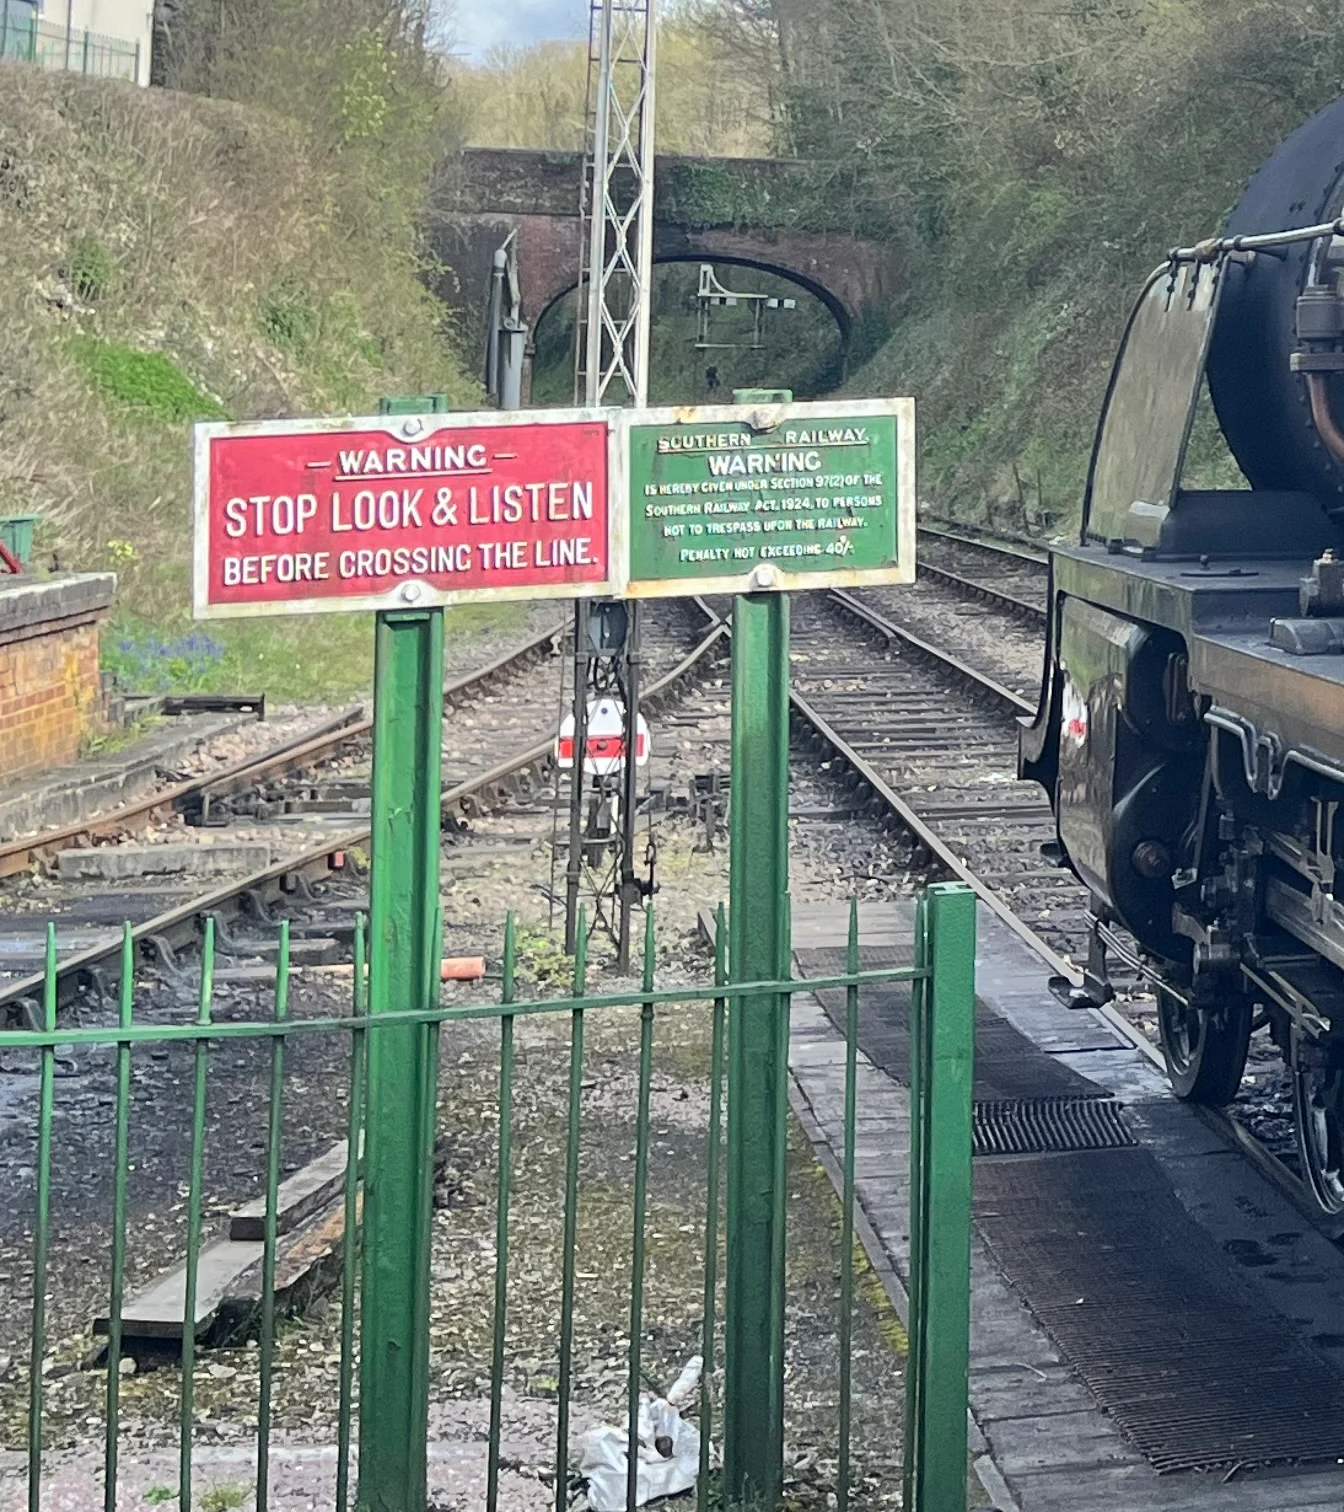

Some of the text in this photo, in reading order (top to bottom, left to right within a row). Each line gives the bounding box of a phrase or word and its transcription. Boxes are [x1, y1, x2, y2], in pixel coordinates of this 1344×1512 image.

[658, 433, 751, 449] SOUTHERN
[338, 444, 487, 474] WARNING
[708, 451, 821, 476] WARNING
[644, 484, 657, 496] IS
[660, 483, 700, 495] HEREBY
[700, 481, 733, 494] GIVEN
[734, 479, 768, 491] UNDER
[770, 477, 814, 489] SECTION
[863, 473, 883, 485] THE
[225, 481, 593, 537] STOP LOOK & LISTEN
[645, 504, 701, 517] SOUTHERN
[704, 501, 750, 515] RAILWAY
[815, 497, 830, 508] TO
[833, 495, 882, 507] PERSONS
[664, 524, 686, 537] NOT
[689, 523, 704, 535] TO
[706, 521, 761, 534] TRESPASS
[763, 519, 793, 531] UPON
[795, 518, 815, 529] THE
[224, 538, 599, 585] BEFORE CROSSING THE LINE.
[680, 548, 730, 561] PENALTY
[734, 546, 755, 559] NOT
[760, 543, 822, 557] EXCEEDING
